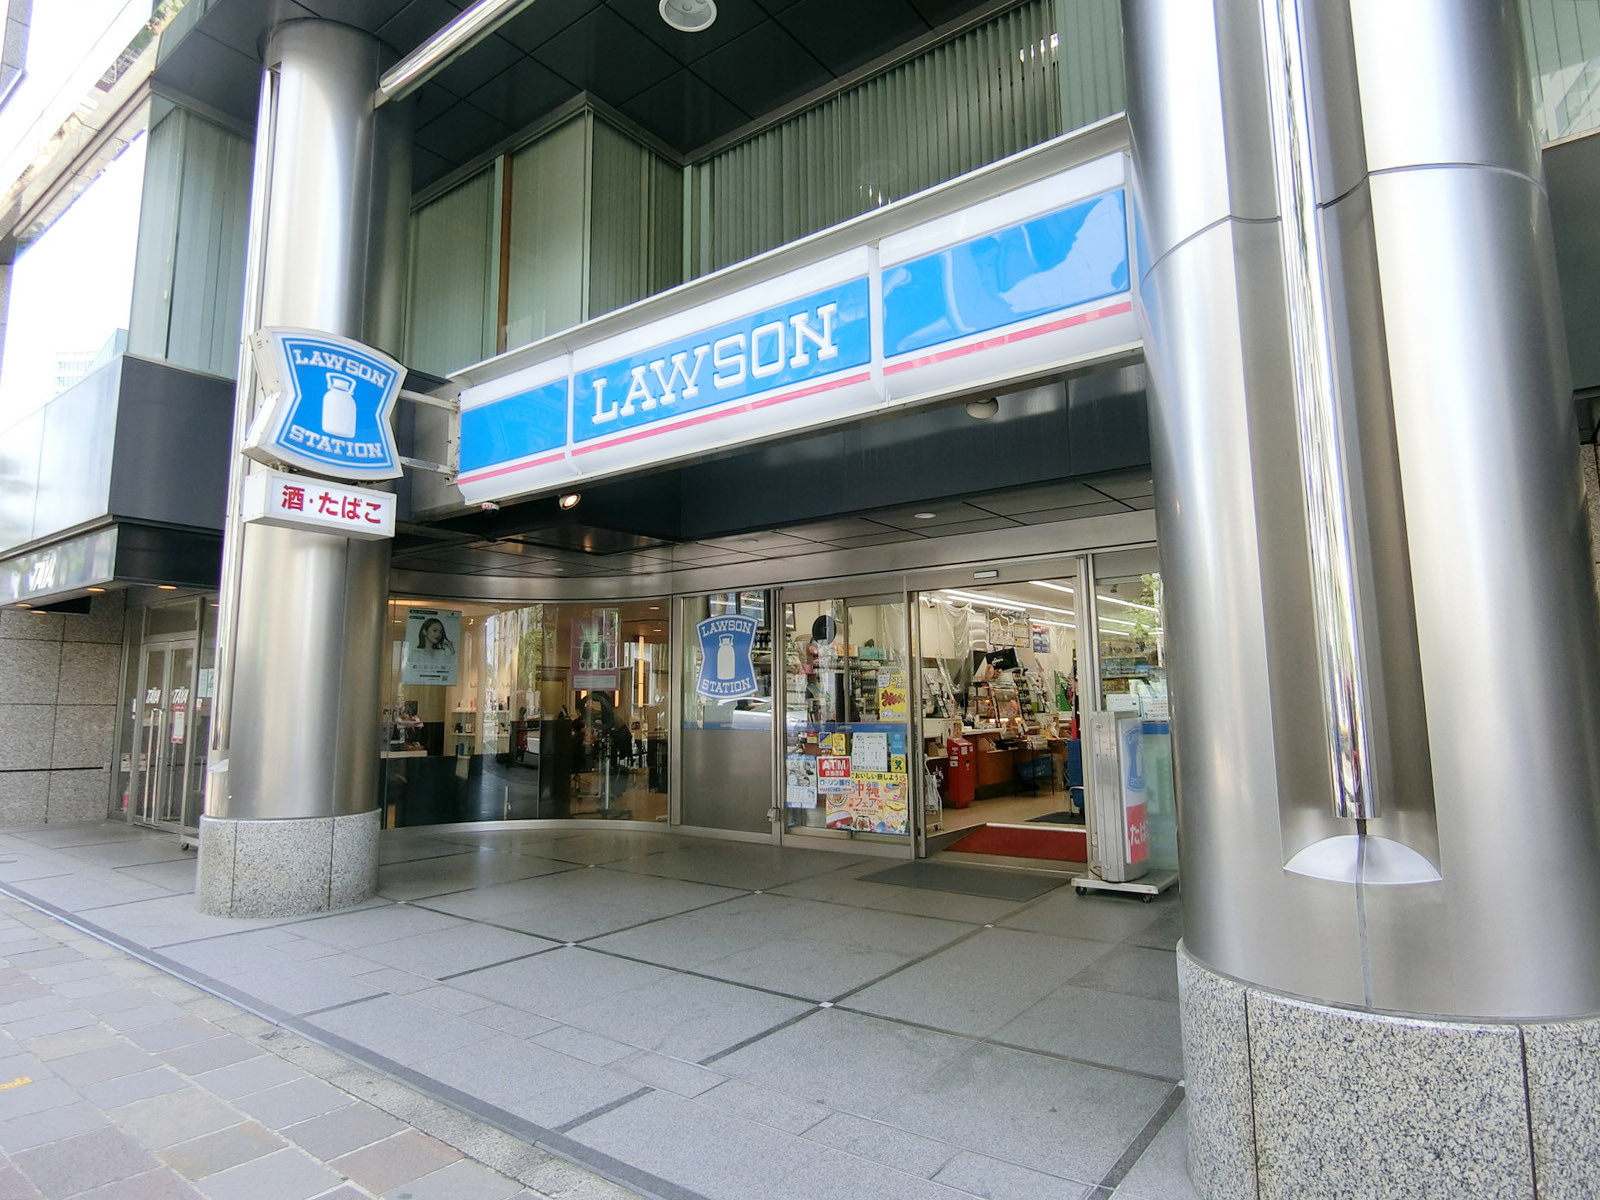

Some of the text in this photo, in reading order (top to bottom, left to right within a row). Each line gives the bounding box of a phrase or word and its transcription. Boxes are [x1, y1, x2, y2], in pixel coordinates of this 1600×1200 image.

[294, 349, 388, 389] LAWSON
[592, 302, 839, 425] LAWSON
[289, 424, 384, 459] STATION
[281, 484, 382, 524] 酒・たばこ
[701, 620, 752, 637] LAWSON
[701, 677, 751, 694] STATION
[822, 759, 847, 770] ATM
